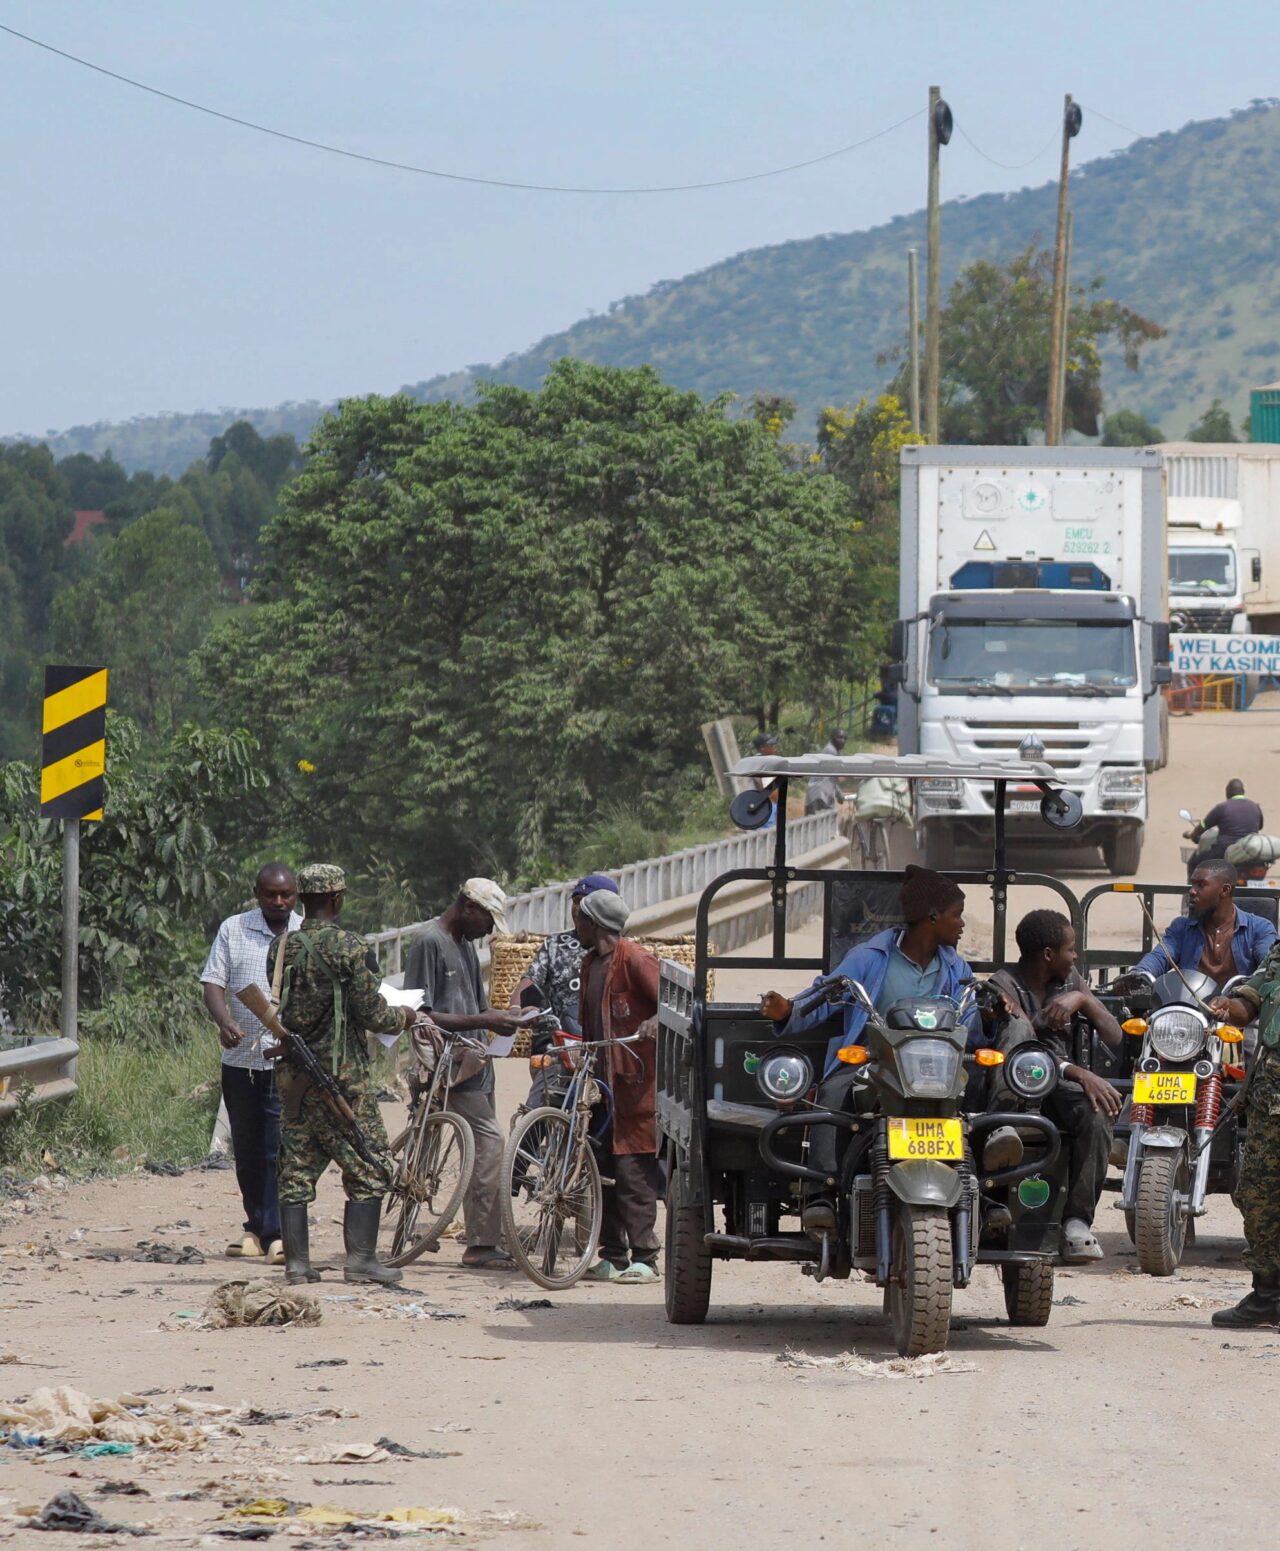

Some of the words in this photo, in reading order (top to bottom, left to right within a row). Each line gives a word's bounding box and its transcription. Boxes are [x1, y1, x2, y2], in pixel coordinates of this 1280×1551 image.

[1065, 527, 1092, 540] EMCU
[1179, 656, 1204, 670] BY
[1157, 1076, 1181, 1088] UMA
[1148, 1089, 1188, 1101] 465FC
[915, 1122, 945, 1138] UMA
[908, 1140, 956, 1155] 688FX
